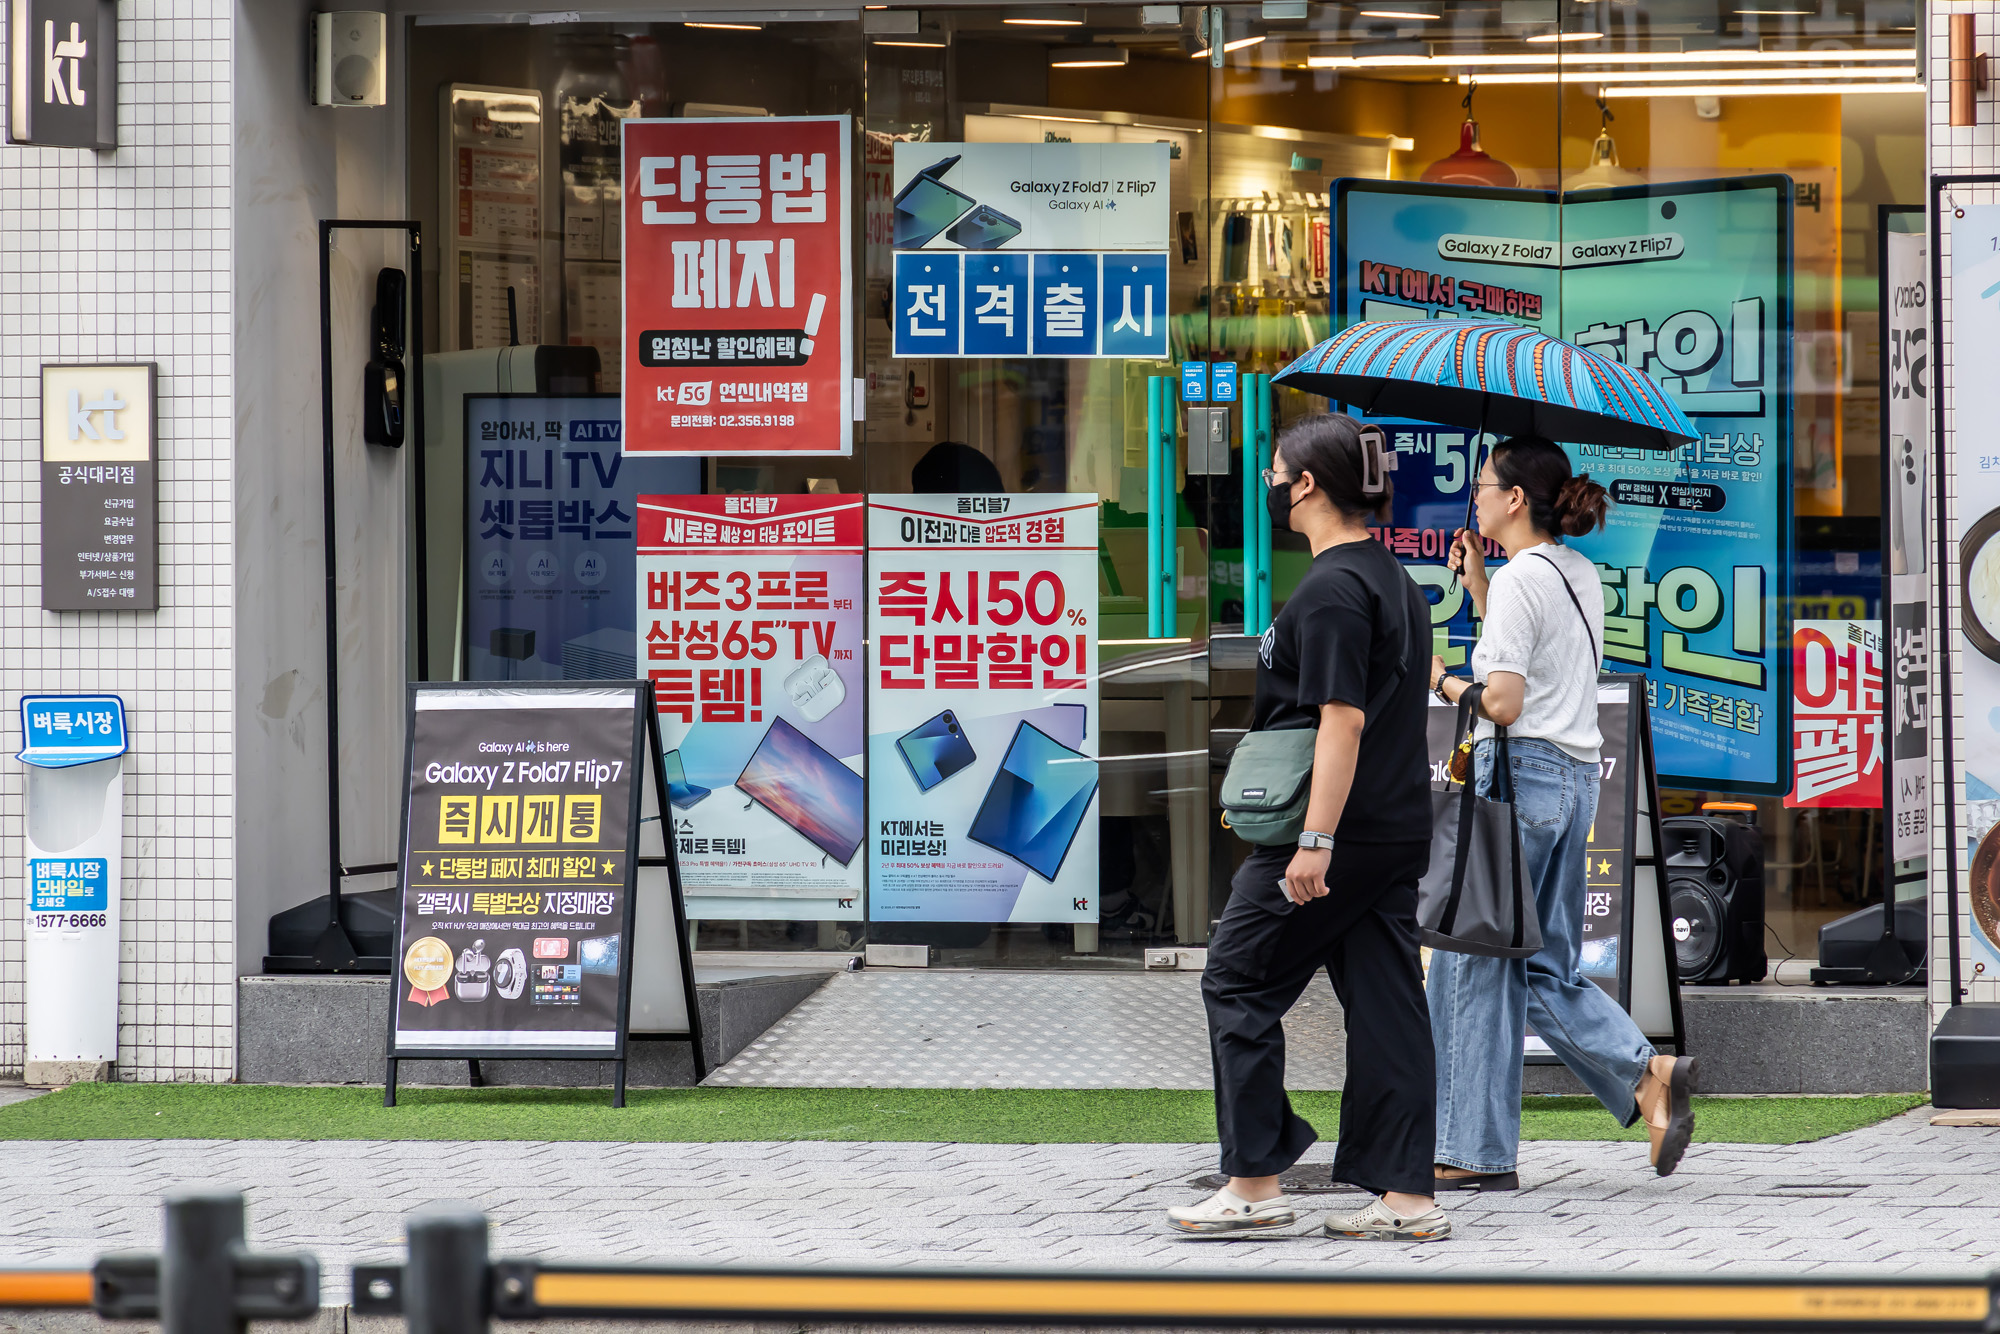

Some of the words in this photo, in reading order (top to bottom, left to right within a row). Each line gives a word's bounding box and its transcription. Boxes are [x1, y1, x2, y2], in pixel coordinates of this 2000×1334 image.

[44, 19, 87, 106] kt
[640, 153, 827, 225] 단통법
[1010, 180, 1060, 196] Galaxy
[1062, 181, 1070, 193] Z
[1072, 180, 1109, 193] Fold7
[1116, 181, 1124, 193] Z
[1127, 180, 1157, 197] Flip7
[1049, 199, 1090, 213] Galaxy
[1093, 199, 1103, 210] AI
[1445, 239, 1500, 258] Galaxy
[1502, 243, 1510, 256] Z
[1513, 244, 1553, 260] Fold7
[1572, 241, 1627, 260] Galaxy
[1629, 240, 1637, 254] Z
[1640, 237, 1673, 255] Flip7
[671, 238, 795, 309] 폐지
[1361, 260, 1456, 307] KT에서
[1459, 279, 1543, 320] 구매하면
[652, 337, 711, 360] 엄청난
[657, 385, 675, 402] kt
[682, 389, 706, 402] 5G
[719, 381, 808, 403] 연신내역점
[67, 388, 127, 442] kt
[671, 414, 717, 428] 문의전화:
[719, 414, 795, 428] 02.356.9198
[480, 420, 542, 443] 알아서,
[544, 420, 563, 441] 딱
[574, 423, 593, 439] AI
[597, 423, 619, 439] TV
[1394, 432, 1432, 455] 즉시
[58, 466, 135, 485] 공식대리점
[479, 449, 553, 490] 지니
[562, 450, 623, 489] TV
[1580, 462, 1595, 473] 2년
[1597, 463, 1606, 473] 후
[1608, 463, 1626, 475] 최대
[1628, 465, 1651, 476] 50%
[1653, 466, 1673, 478] 보상
[1701, 469, 1719, 480] 지금
[1721, 470, 1740, 481] 바로
[1741, 471, 1763, 483] 할인!
[1618, 483, 1632, 492] NEW
[1633, 483, 1655, 494] 갤럭시
[1671, 486, 1712, 499] 안심체인지
[104, 498, 134, 509] 신규가입
[725, 496, 778, 514] 폴더블7
[957, 496, 1011, 514] 폴더블7
[1618, 493, 1625, 503] AI
[1626, 494, 1654, 504] 구독클럽
[104, 517, 134, 527] 요금수납
[479, 499, 632, 541] 셋톱박스
[663, 516, 717, 544] 새로운
[759, 524, 780, 544] 터닝
[782, 515, 836, 543] 포인트
[901, 516, 957, 544] 이전과
[960, 524, 981, 544] 다른
[985, 522, 1021, 544] 압도적
[1026, 516, 1065, 544] 경험
[104, 534, 134, 545] 변경업무
[77, 552, 134, 562] 인터넷/상품가입
[492, 558, 503, 569] AI
[538, 558, 549, 569] AI
[585, 559, 596, 569] AI
[79, 569, 117, 580] 부가서비스
[119, 569, 134, 580] 신청
[87, 588, 117, 599] A/S접수
[119, 587, 135, 598] 대행
[879, 631, 1088, 690] 단말할인
[654, 667, 763, 723] 득템!
[1664, 682, 1764, 737] 가족결합
[32, 711, 114, 736] 벼룩시장
[478, 742, 513, 756] Galaxy
[515, 742, 525, 753] AI
[537, 741, 545, 752] is
[546, 741, 570, 753] here
[425, 761, 499, 791] Galaxy
[502, 761, 516, 784] Z
[518, 760, 571, 784] Fold7
[574, 758, 624, 790] Flip7
[444, 800, 596, 839] 즉시개통
[880, 820, 945, 838] KT에서는
[712, 837, 747, 855] 득템!
[880, 839, 947, 857] 미리보상!
[36, 861, 101, 879] 벼룩시장
[439, 857, 488, 880] 단통법
[490, 857, 524, 880] 폐지
[526, 856, 560, 879] 최대
[562, 855, 597, 879] 할인
[896, 862, 906, 870] 최대
[907, 862, 920, 870] 50%
[920, 862, 930, 870] 보상
[946, 862, 956, 870] 지금
[957, 862, 967, 870] 바로
[967, 862, 987, 870] 할인으로
[36, 879, 95, 898] 모바일로
[36, 896, 66, 908] 보세요
[416, 891, 469, 916] 갤럭시
[472, 891, 541, 916] 특별보상
[543, 890, 615, 916] 지정매장
[1073, 896, 1089, 911] kt
[35, 913, 107, 928] 1577-6666
[431, 921, 444, 931] 오직
[444, 921, 453, 931] KT
[466, 921, 478, 931] 우리
[512, 921, 530, 931] 역대급
[531, 921, 550, 931] 최고의
[550, 921, 568, 931] 혜택을
[569, 921, 596, 931] 드립니다!
